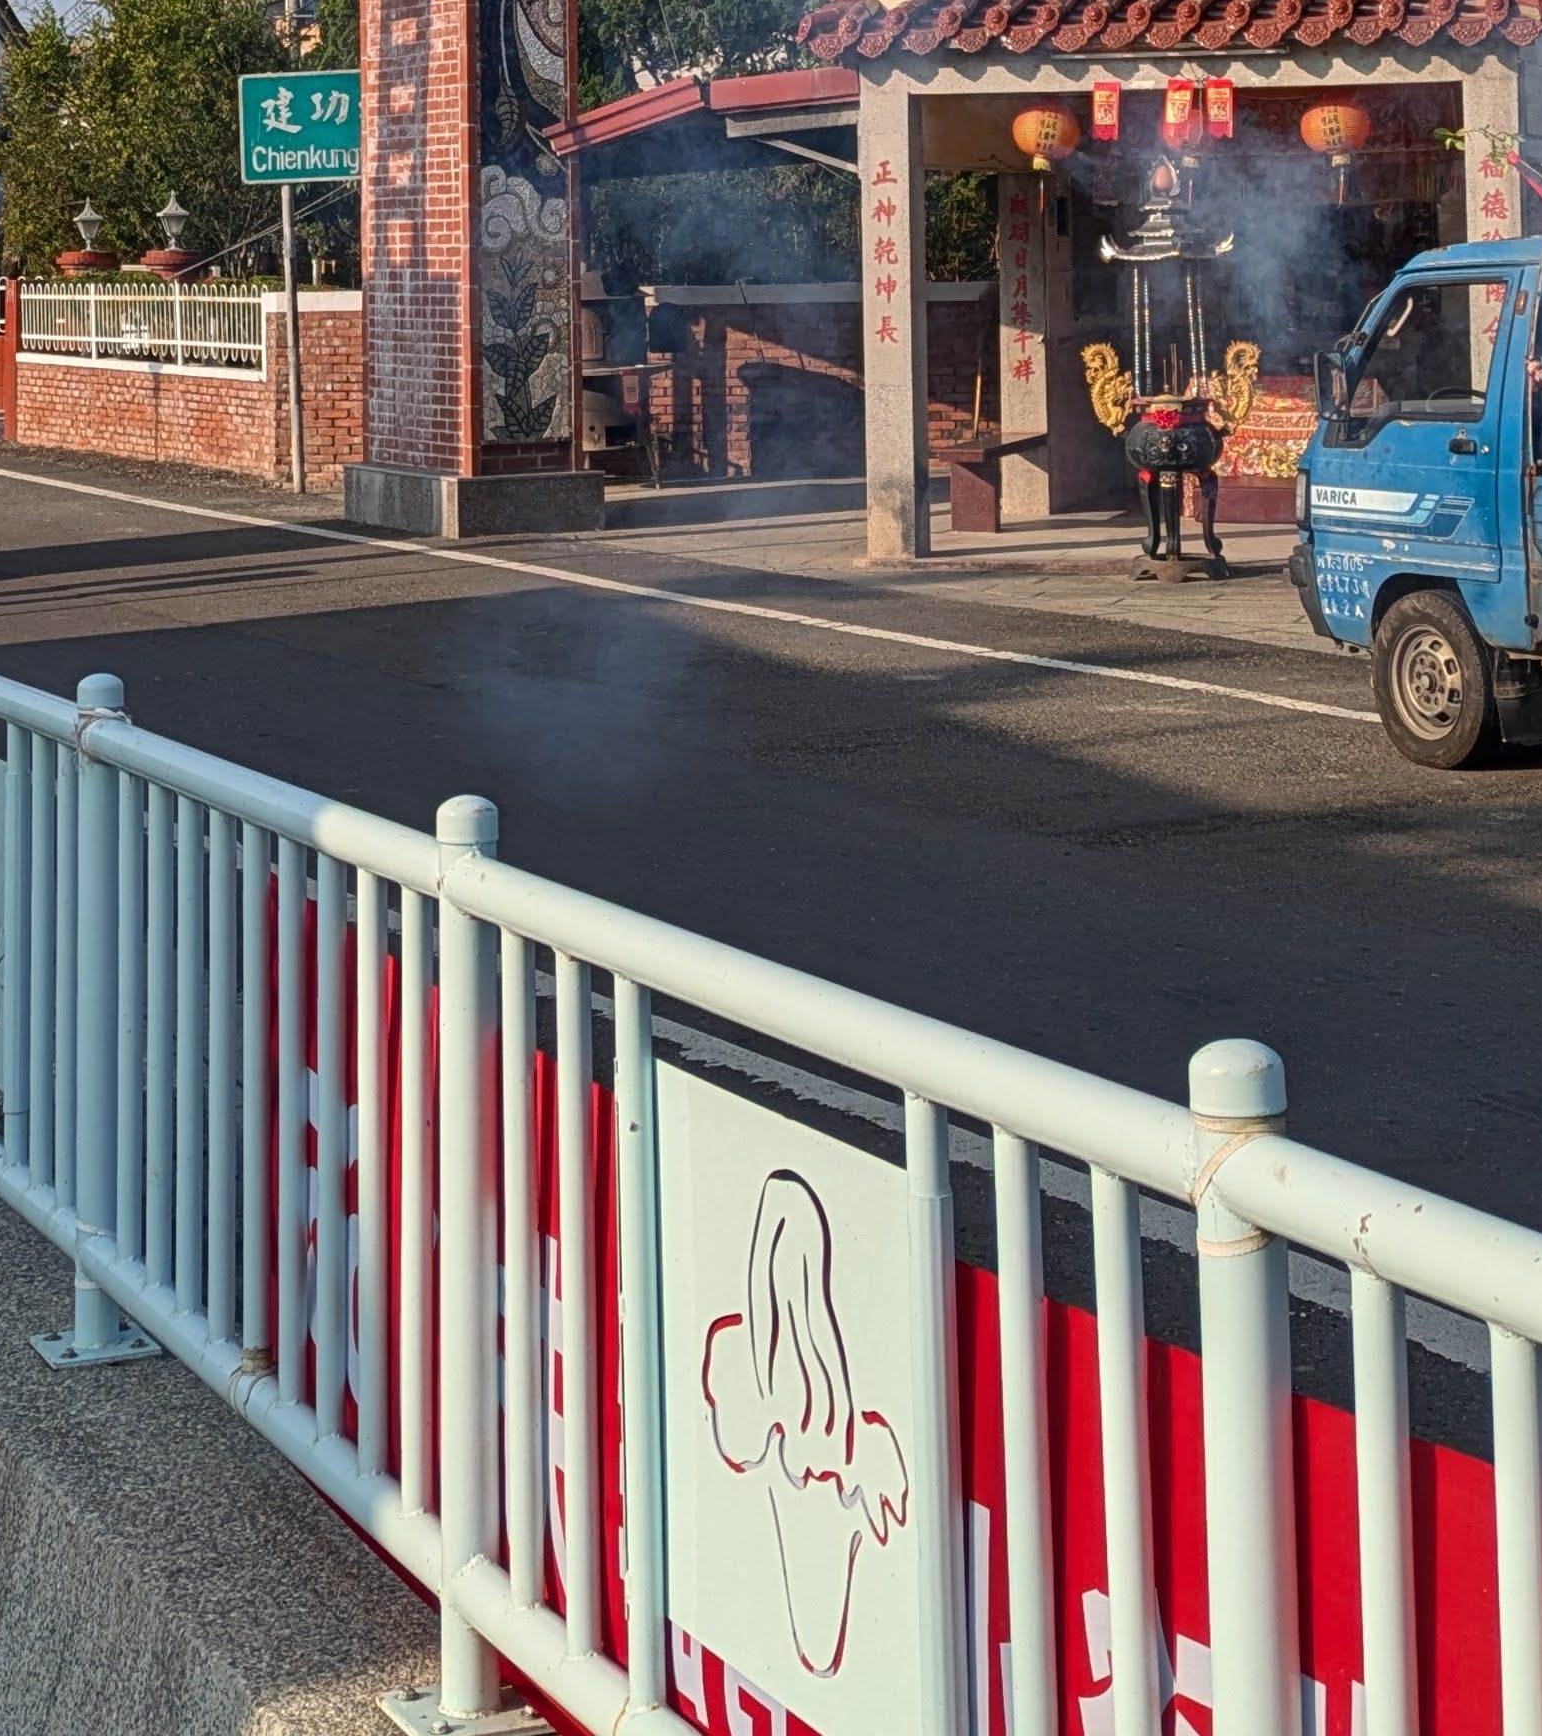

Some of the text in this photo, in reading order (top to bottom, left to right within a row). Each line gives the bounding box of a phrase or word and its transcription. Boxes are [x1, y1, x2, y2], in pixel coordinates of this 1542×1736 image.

[260, 86, 361, 134] 建功
[252, 144, 360, 175] Chienkung
[871, 160, 899, 344] 正神乾坤長
[1316, 488, 1358, 506] VARICA
